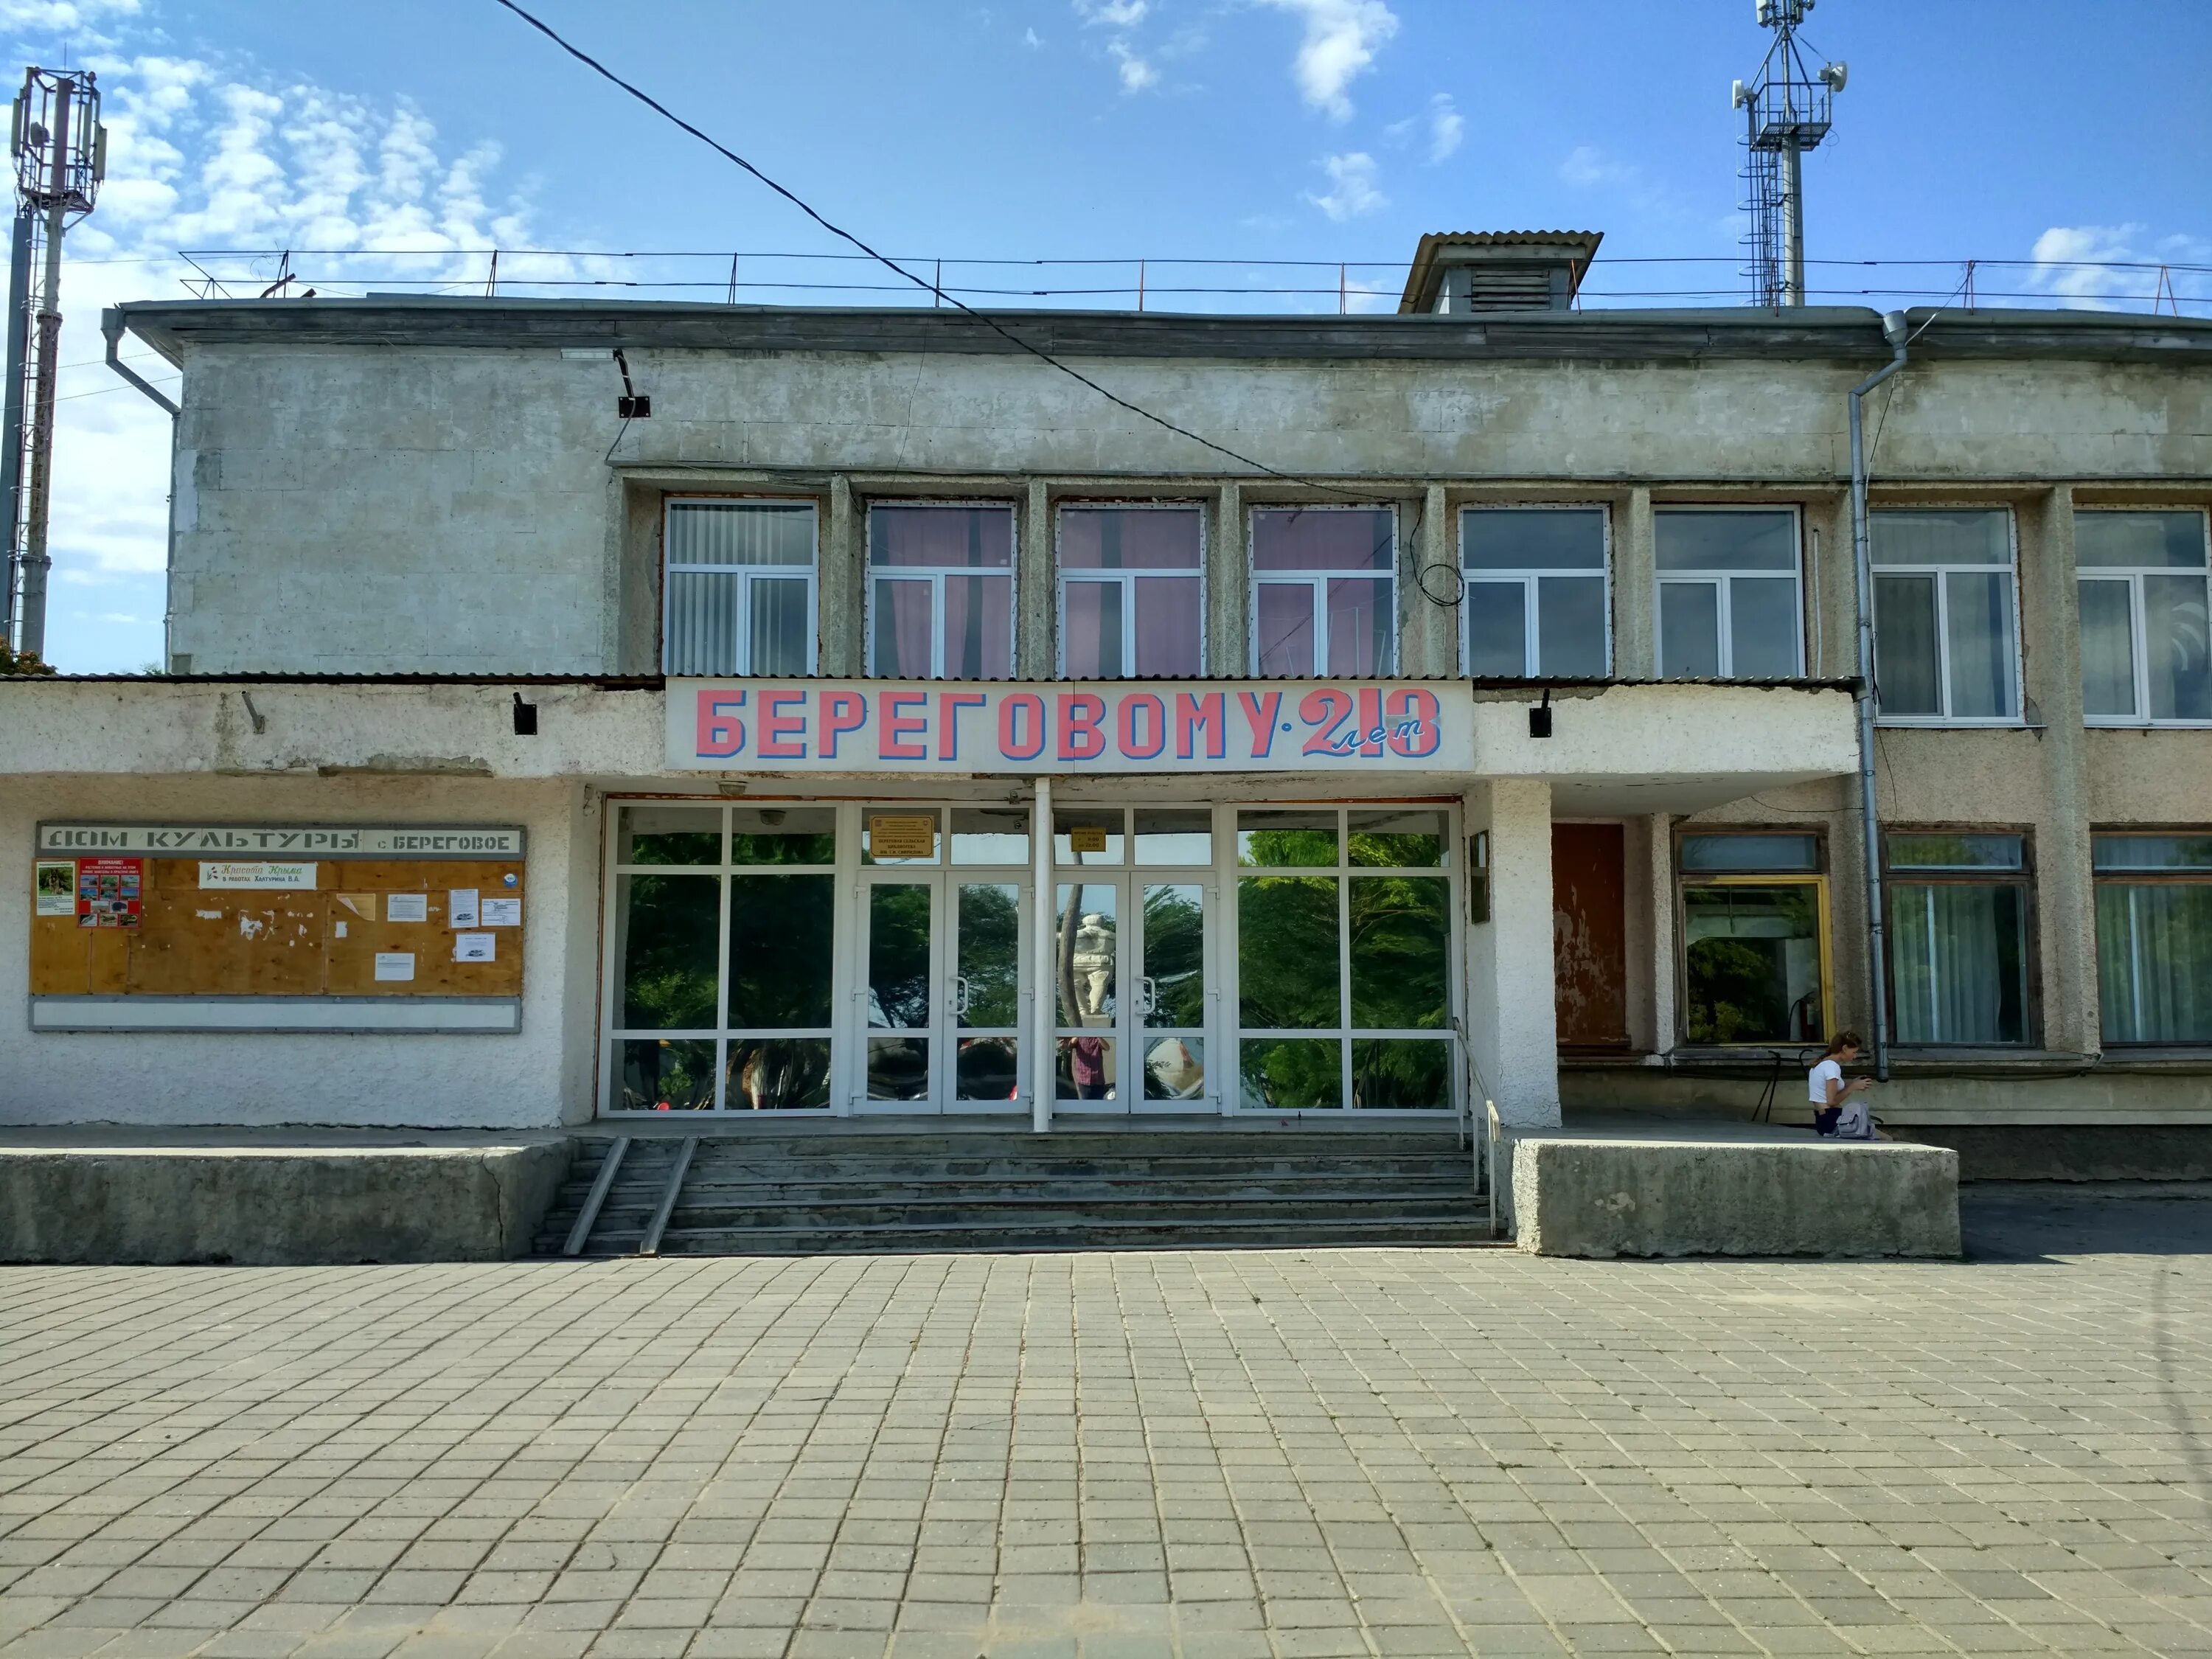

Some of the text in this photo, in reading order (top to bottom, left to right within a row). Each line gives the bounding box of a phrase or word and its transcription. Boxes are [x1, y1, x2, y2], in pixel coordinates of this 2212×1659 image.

[697, 690, 1281, 761] БЕРЕГОВОМУ
[1332, 718, 1425, 751] лет
[48, 830, 128, 846] ДОМ
[147, 831, 359, 849] КУЛЬТУРЫ
[393, 836, 509, 850] БЕРЕГОВОЕ
[221, 864, 302, 876] Красота Крыма
